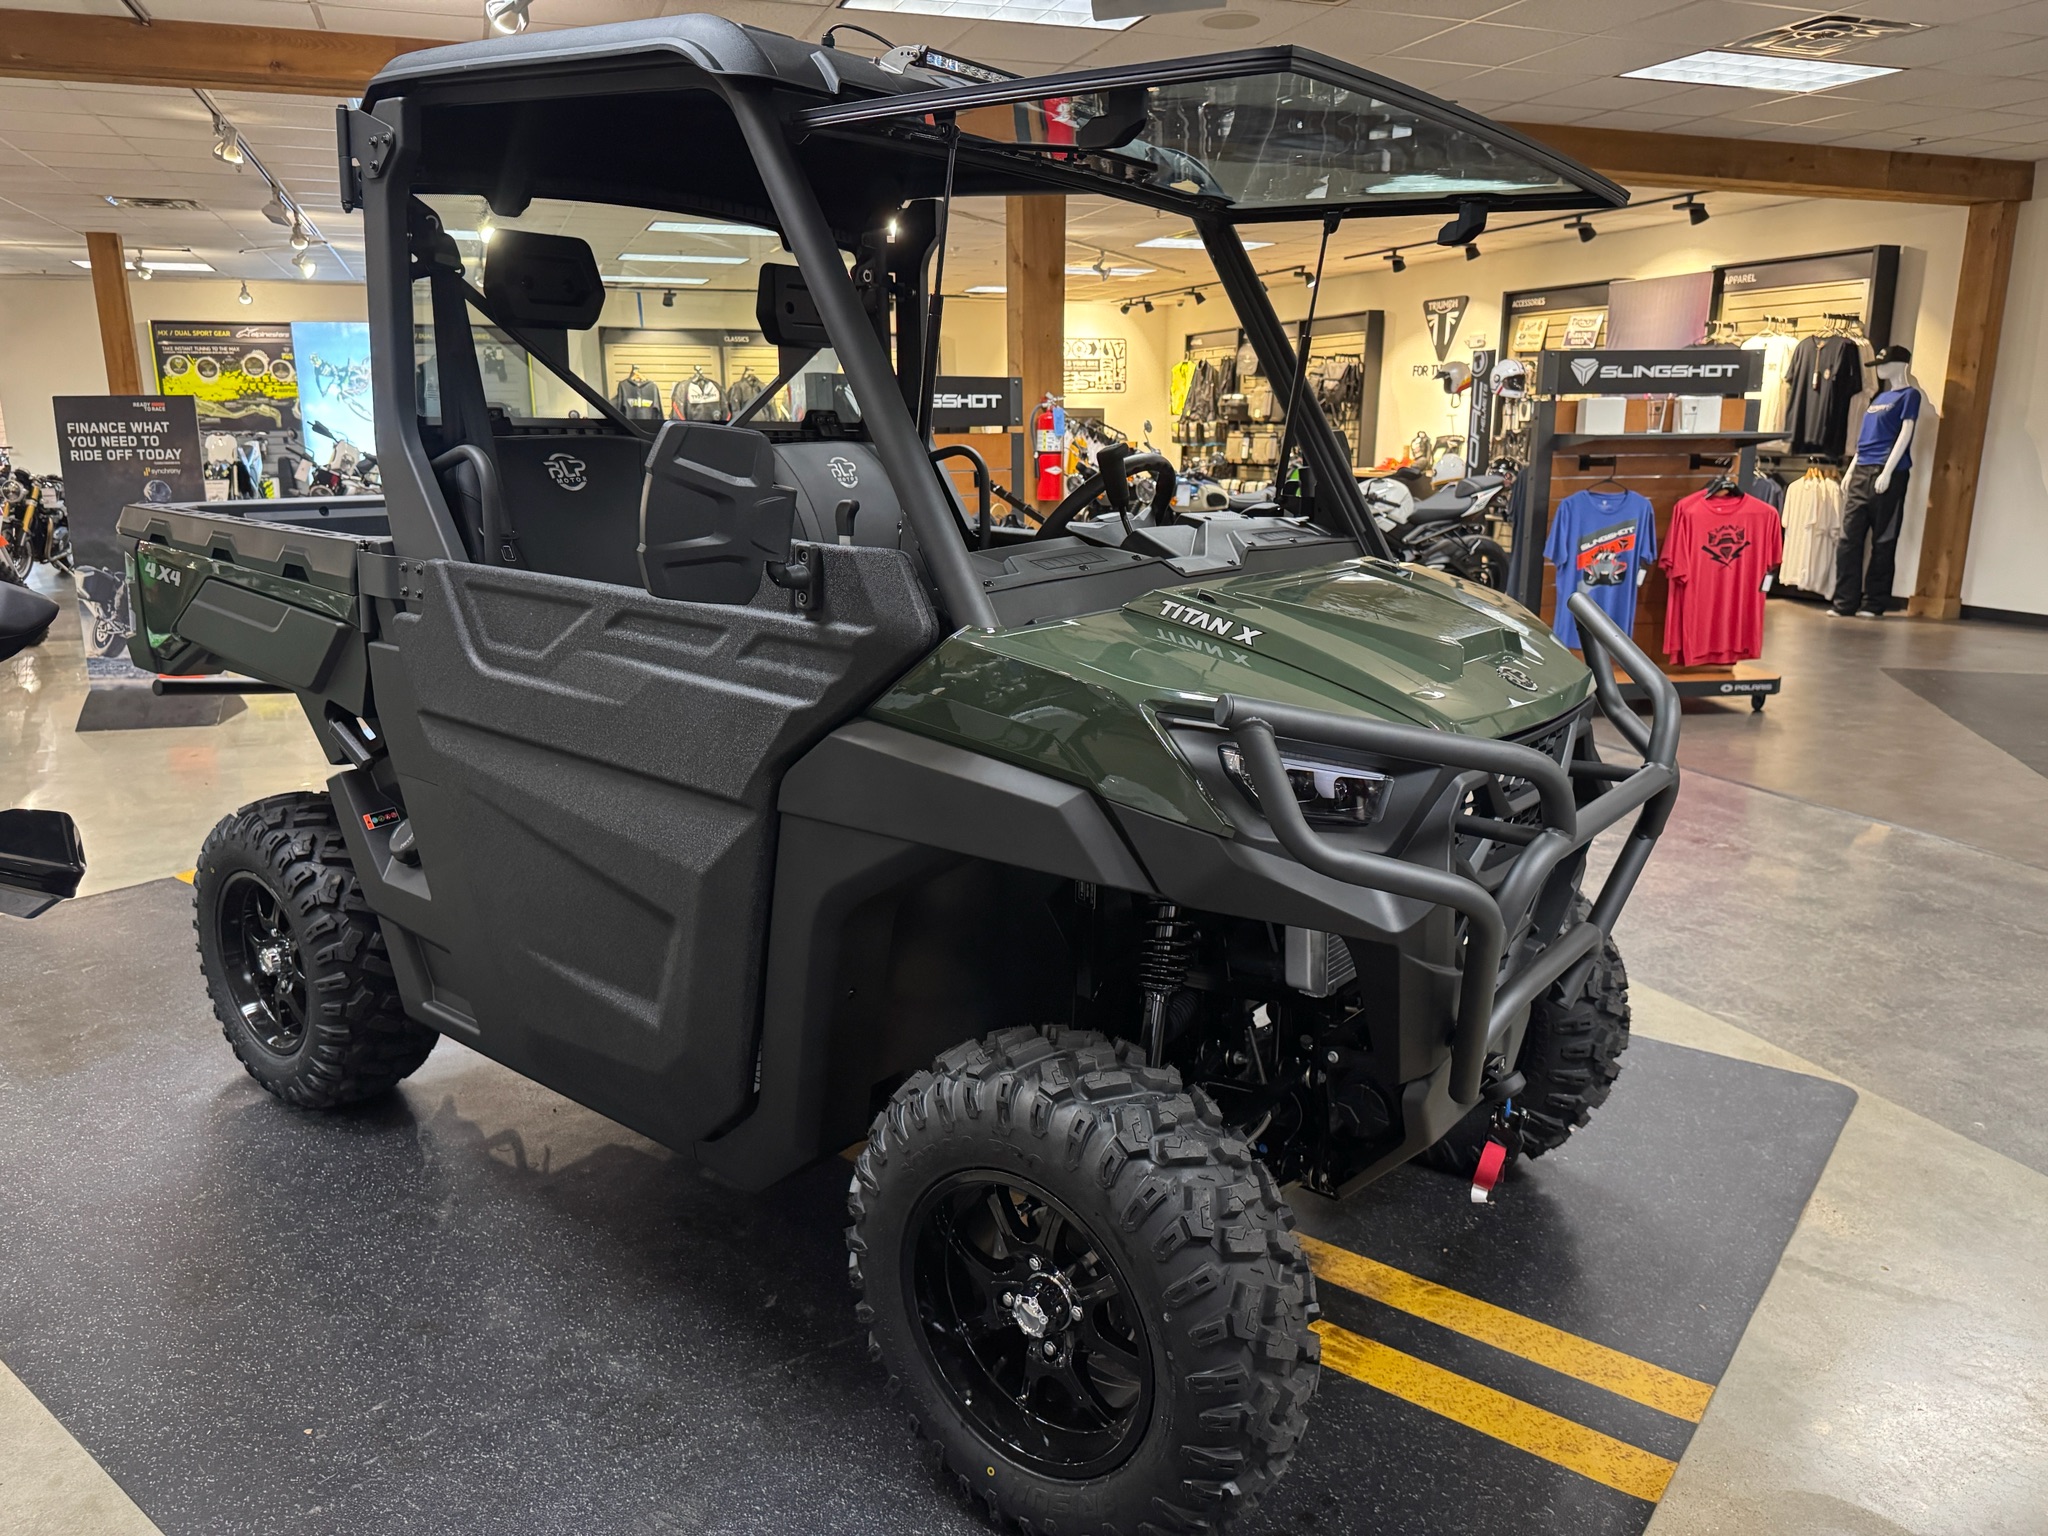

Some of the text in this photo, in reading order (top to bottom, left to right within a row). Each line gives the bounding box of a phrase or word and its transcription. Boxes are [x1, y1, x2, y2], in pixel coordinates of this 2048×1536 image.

[1724, 274, 1757, 285] APPAREL
[1428, 299, 1459, 312] TRIUMPH
[1512, 297, 1546, 308] ACCESSORIES
[1412, 365, 1429, 377] FOR
[1600, 364, 1740, 378] SLINGSHOT
[67, 421, 169, 434] FINANCE WHAT
[68, 435, 160, 447] YOU NEED TO
[70, 449, 182, 461] RIDE OFF TODAY
[151, 467, 181, 475] synchrony
[1580, 526, 1635, 551] SLINGSHOT
[144, 562, 181, 587] 4X4
[1160, 600, 1263, 646] TITAN X
[1734, 683, 1773, 692] POLARIS
